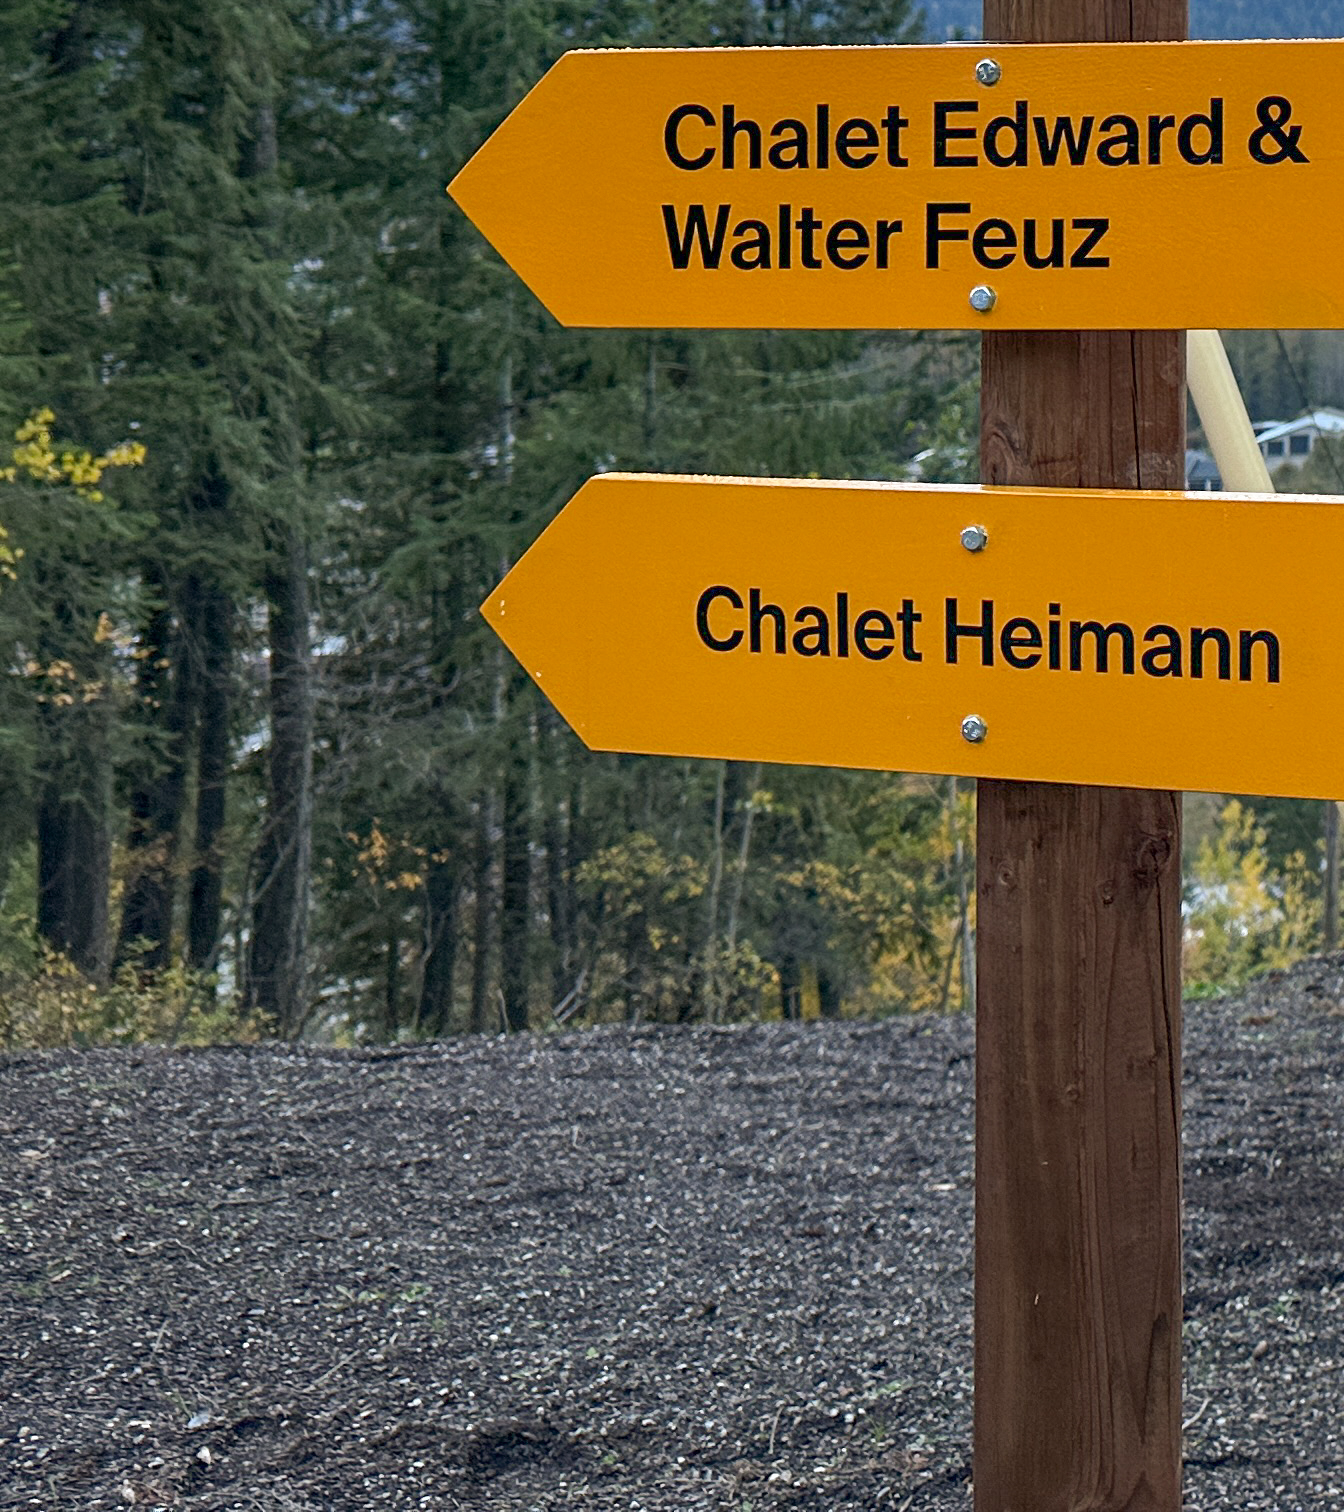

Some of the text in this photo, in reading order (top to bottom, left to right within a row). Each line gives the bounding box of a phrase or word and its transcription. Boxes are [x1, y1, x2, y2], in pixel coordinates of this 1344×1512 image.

[664, 95, 1311, 171] Chalet Edward &
[661, 202, 1110, 271] Walter Feuz
[696, 585, 1280, 684] Chalet Heimann
